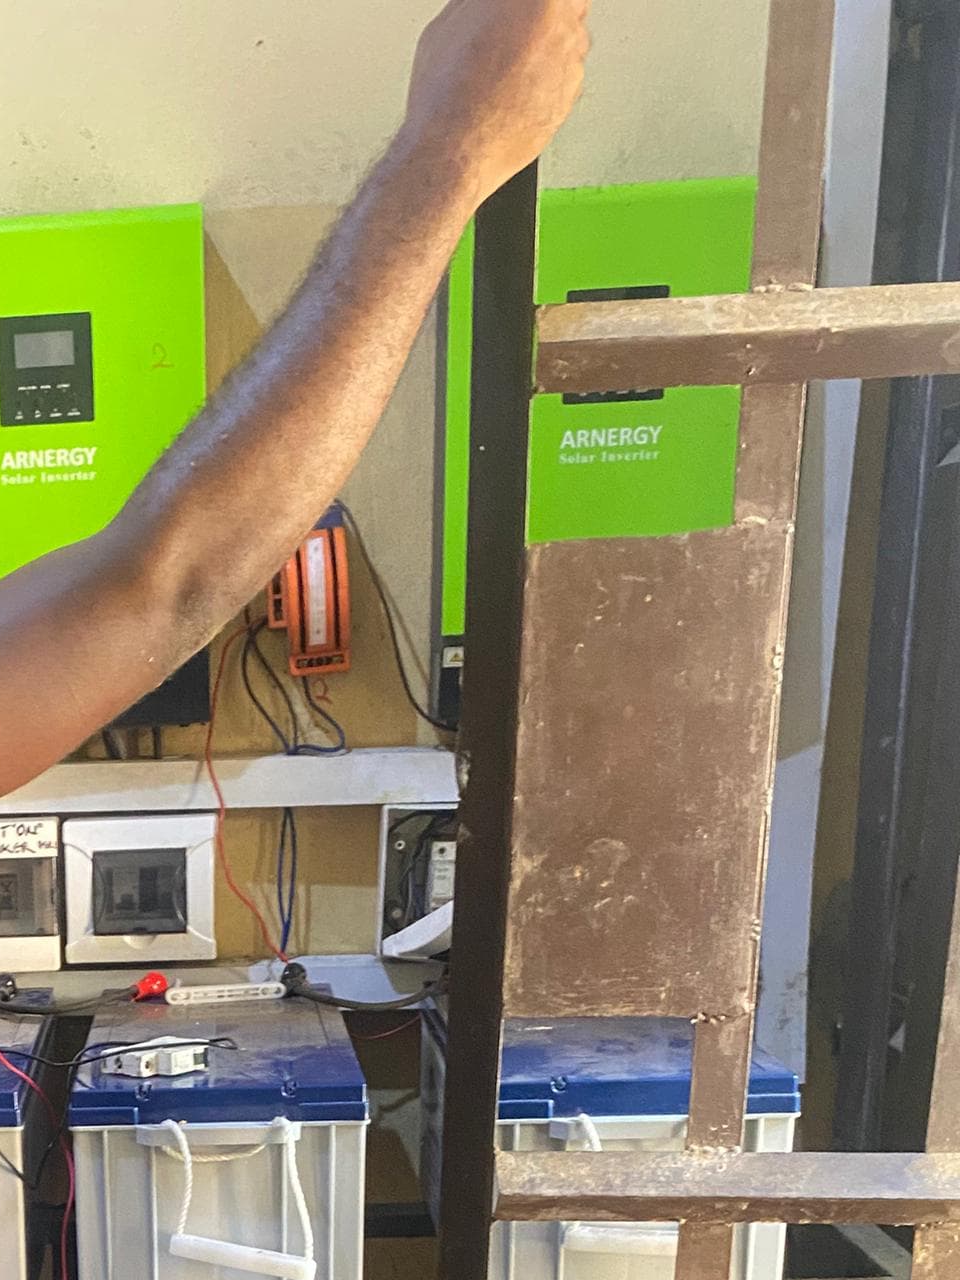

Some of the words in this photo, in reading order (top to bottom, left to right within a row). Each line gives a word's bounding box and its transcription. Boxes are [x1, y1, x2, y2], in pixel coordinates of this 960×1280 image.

[151, 342, 175, 369] 2
[559, 425, 663, 449] ARNERGY
[0, 447, 98, 470] ARNERGY
[559, 453, 597, 465] Solar
[600, 450, 661, 463] Inverter
[0, 474, 36, 486] Solar
[40, 471, 97, 483] Inverter
